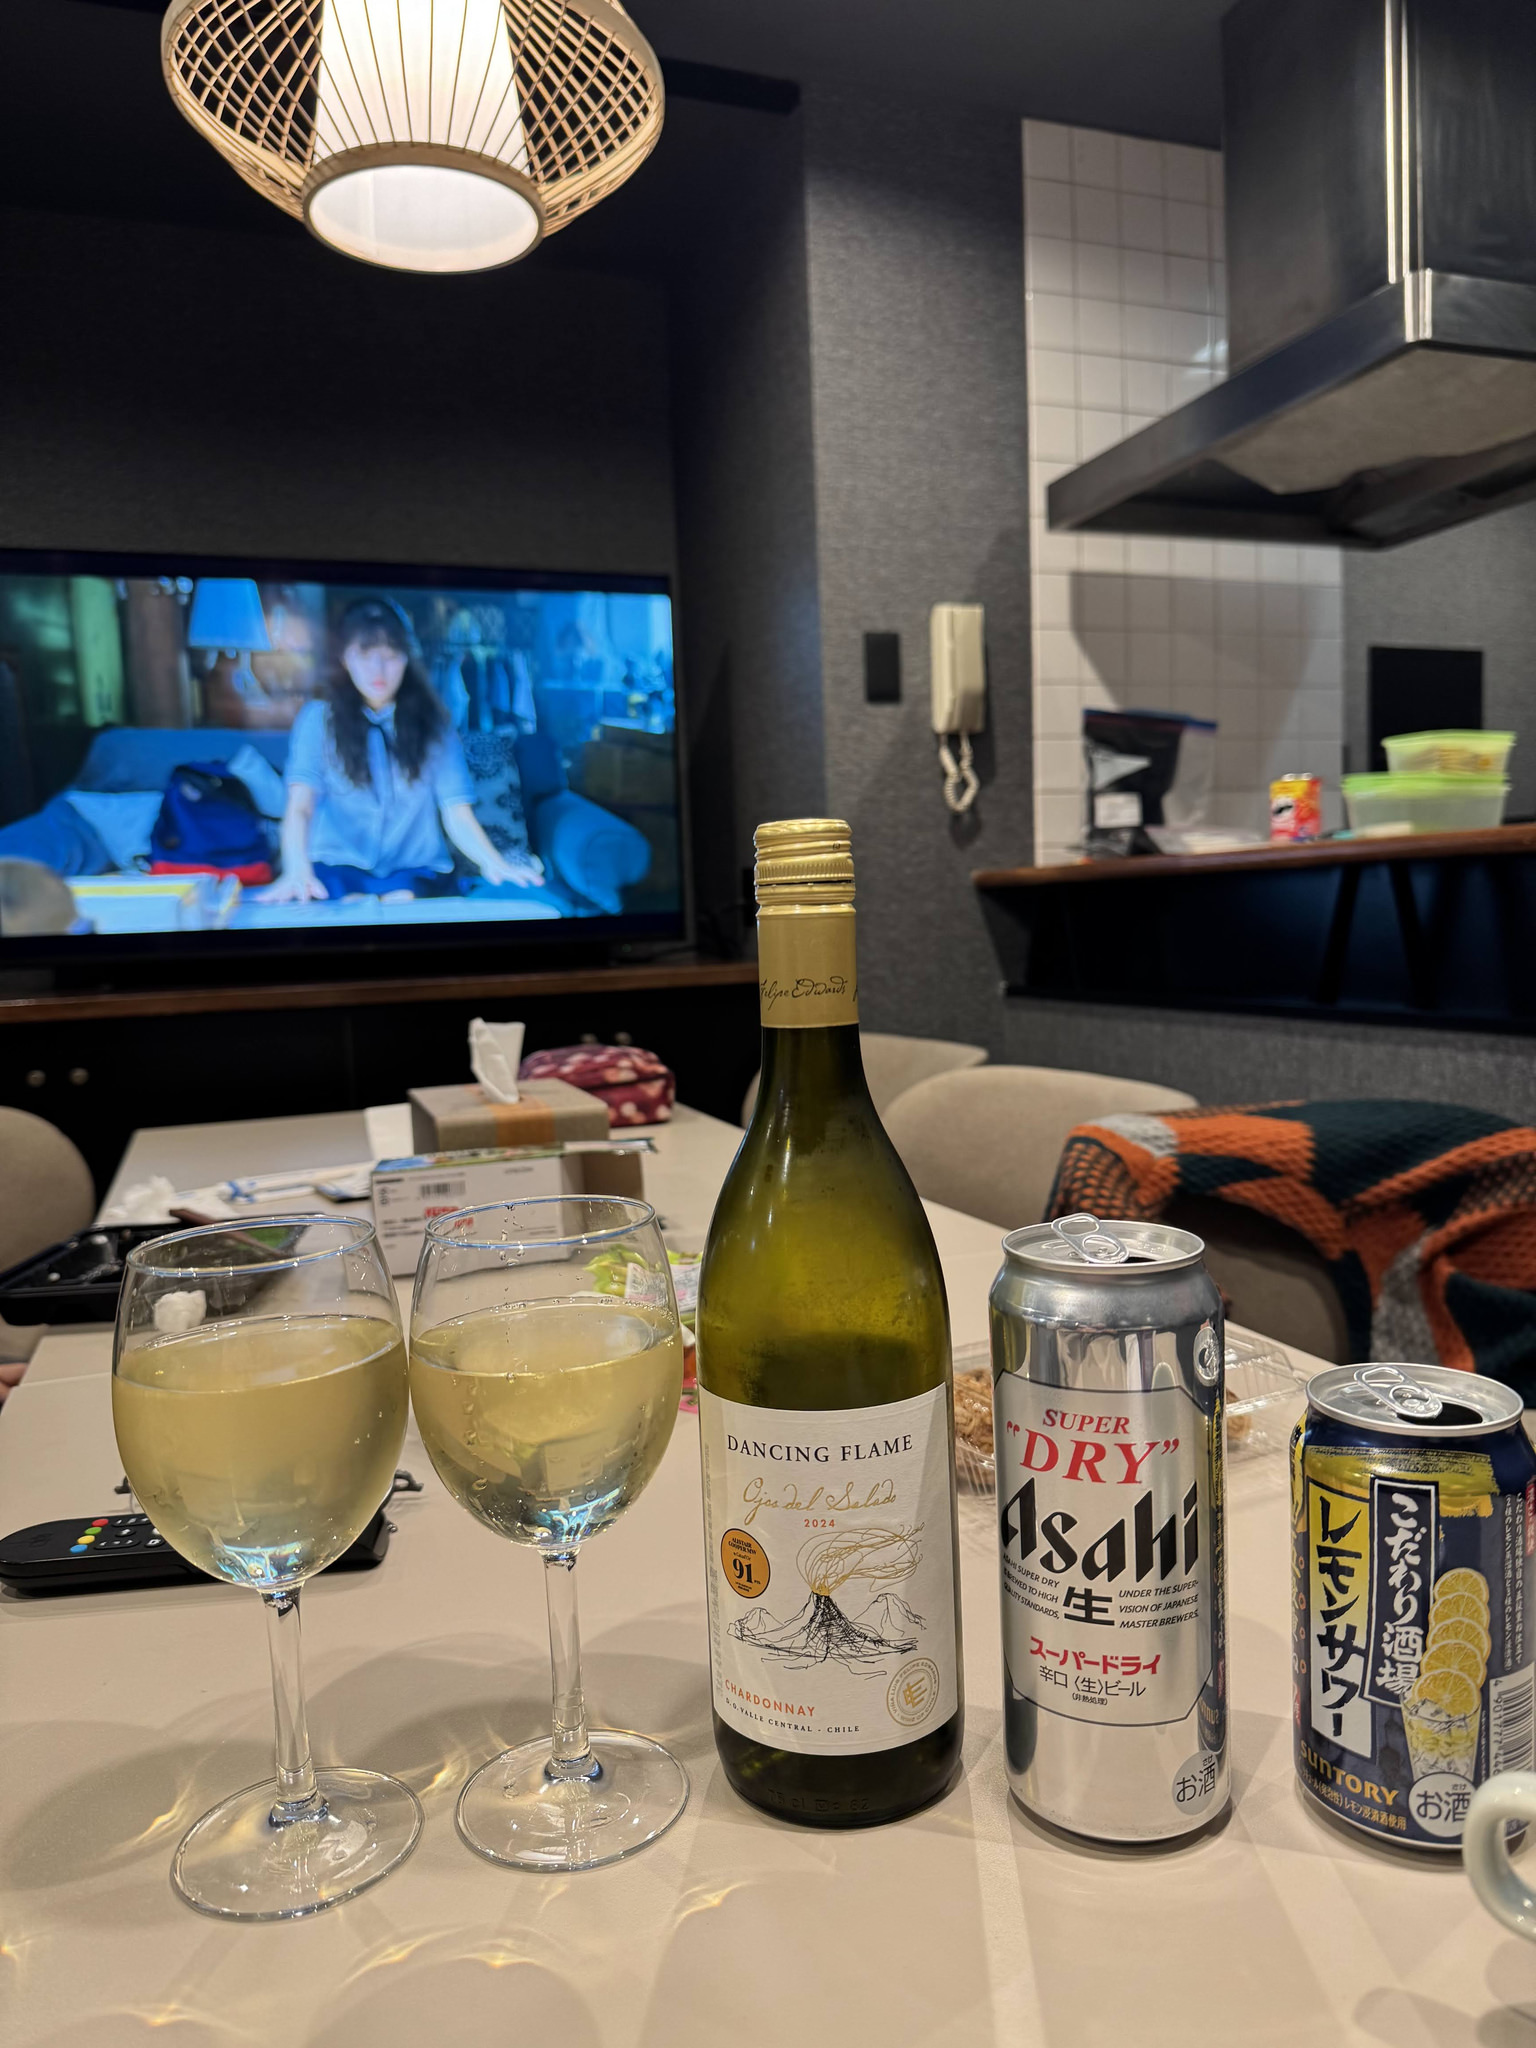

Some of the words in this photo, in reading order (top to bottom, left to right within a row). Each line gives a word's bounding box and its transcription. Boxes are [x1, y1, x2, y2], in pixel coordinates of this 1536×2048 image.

[1042, 1408, 1131, 1435] SUPER
[727, 1434, 830, 1463] DANCING
[840, 1433, 913, 1462] FLAME
[782, 1483, 825, 1512] del
[804, 1518, 836, 1529] 2024
[1001, 1477, 1199, 1583] Asahi
[732, 1558, 754, 1584] 91
[1017, 1565, 1040, 1582] SUPER
[1041, 1577, 1060, 1588] DRY
[1028, 1585, 1038, 1596] TO
[1038, 1590, 1059, 1604] HIGH
[1062, 1585, 1115, 1627] 生
[1119, 1588, 1152, 1598] UNDER
[1154, 1585, 1172, 1596] THE
[1119, 1604, 1150, 1613] VISION
[1150, 1603, 1163, 1612] OF
[1163, 1594, 1199, 1611] JAPANESE
[1375, 1492, 1428, 1701] こだわり酒場
[1021, 1596, 1060, 1620] STANDARDS,
[1316, 1495, 1365, 1737] レモンサワー
[1119, 1618, 1158, 1629] MASTER
[1029, 1634, 1161, 1676] スーパードライ
[724, 1678, 816, 1718] CHARDONNAY
[740, 1707, 764, 1723] VALLE
[768, 1718, 813, 1733] CENTRAL
[827, 1725, 860, 1734] CHILE
[1176, 1761, 1216, 1803] お酒
[1300, 1739, 1400, 1807] SUNTORY
[1416, 1789, 1471, 1823] お酒
